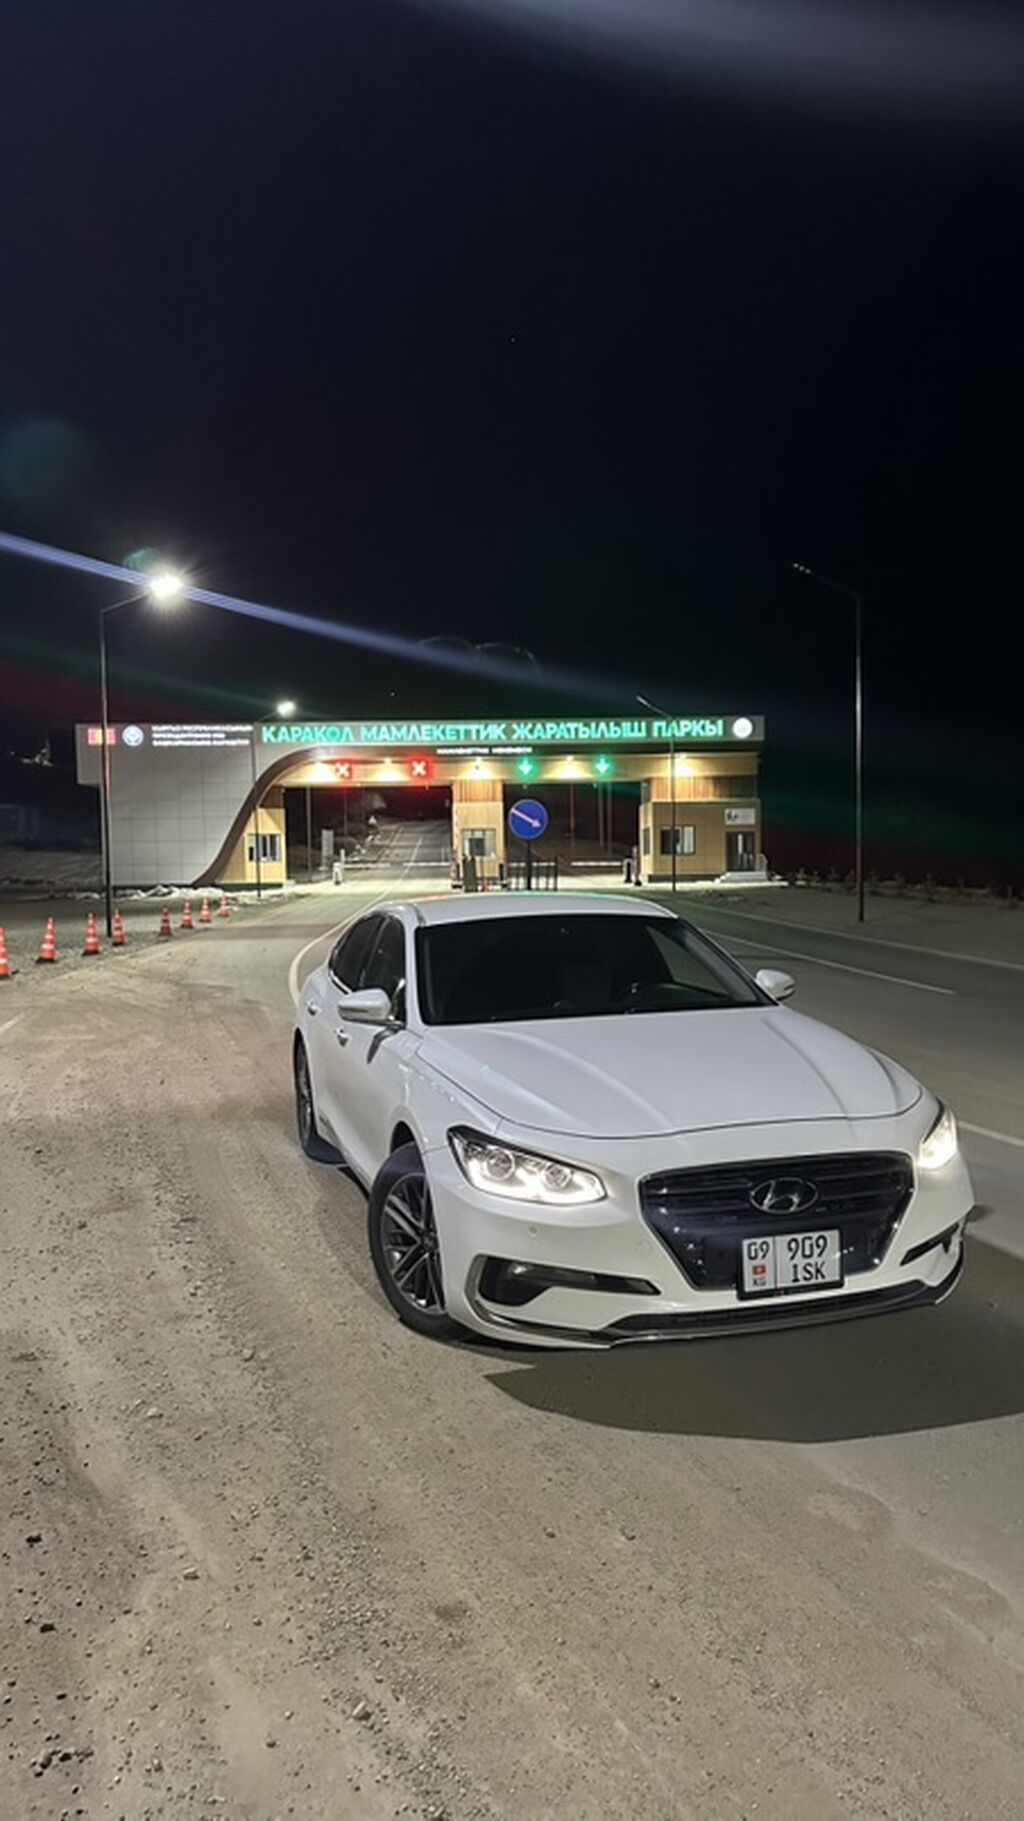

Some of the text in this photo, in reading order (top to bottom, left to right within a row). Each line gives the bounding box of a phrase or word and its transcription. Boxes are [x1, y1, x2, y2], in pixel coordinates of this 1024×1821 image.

[262, 719, 723, 743] КАРАКОЛ МАМЛЕКЕТТИК ЖАРАТЫЛЫШ ПАРКЫ
[748, 1234, 828, 1261] 09 909
[792, 1261, 826, 1283] 1SK
